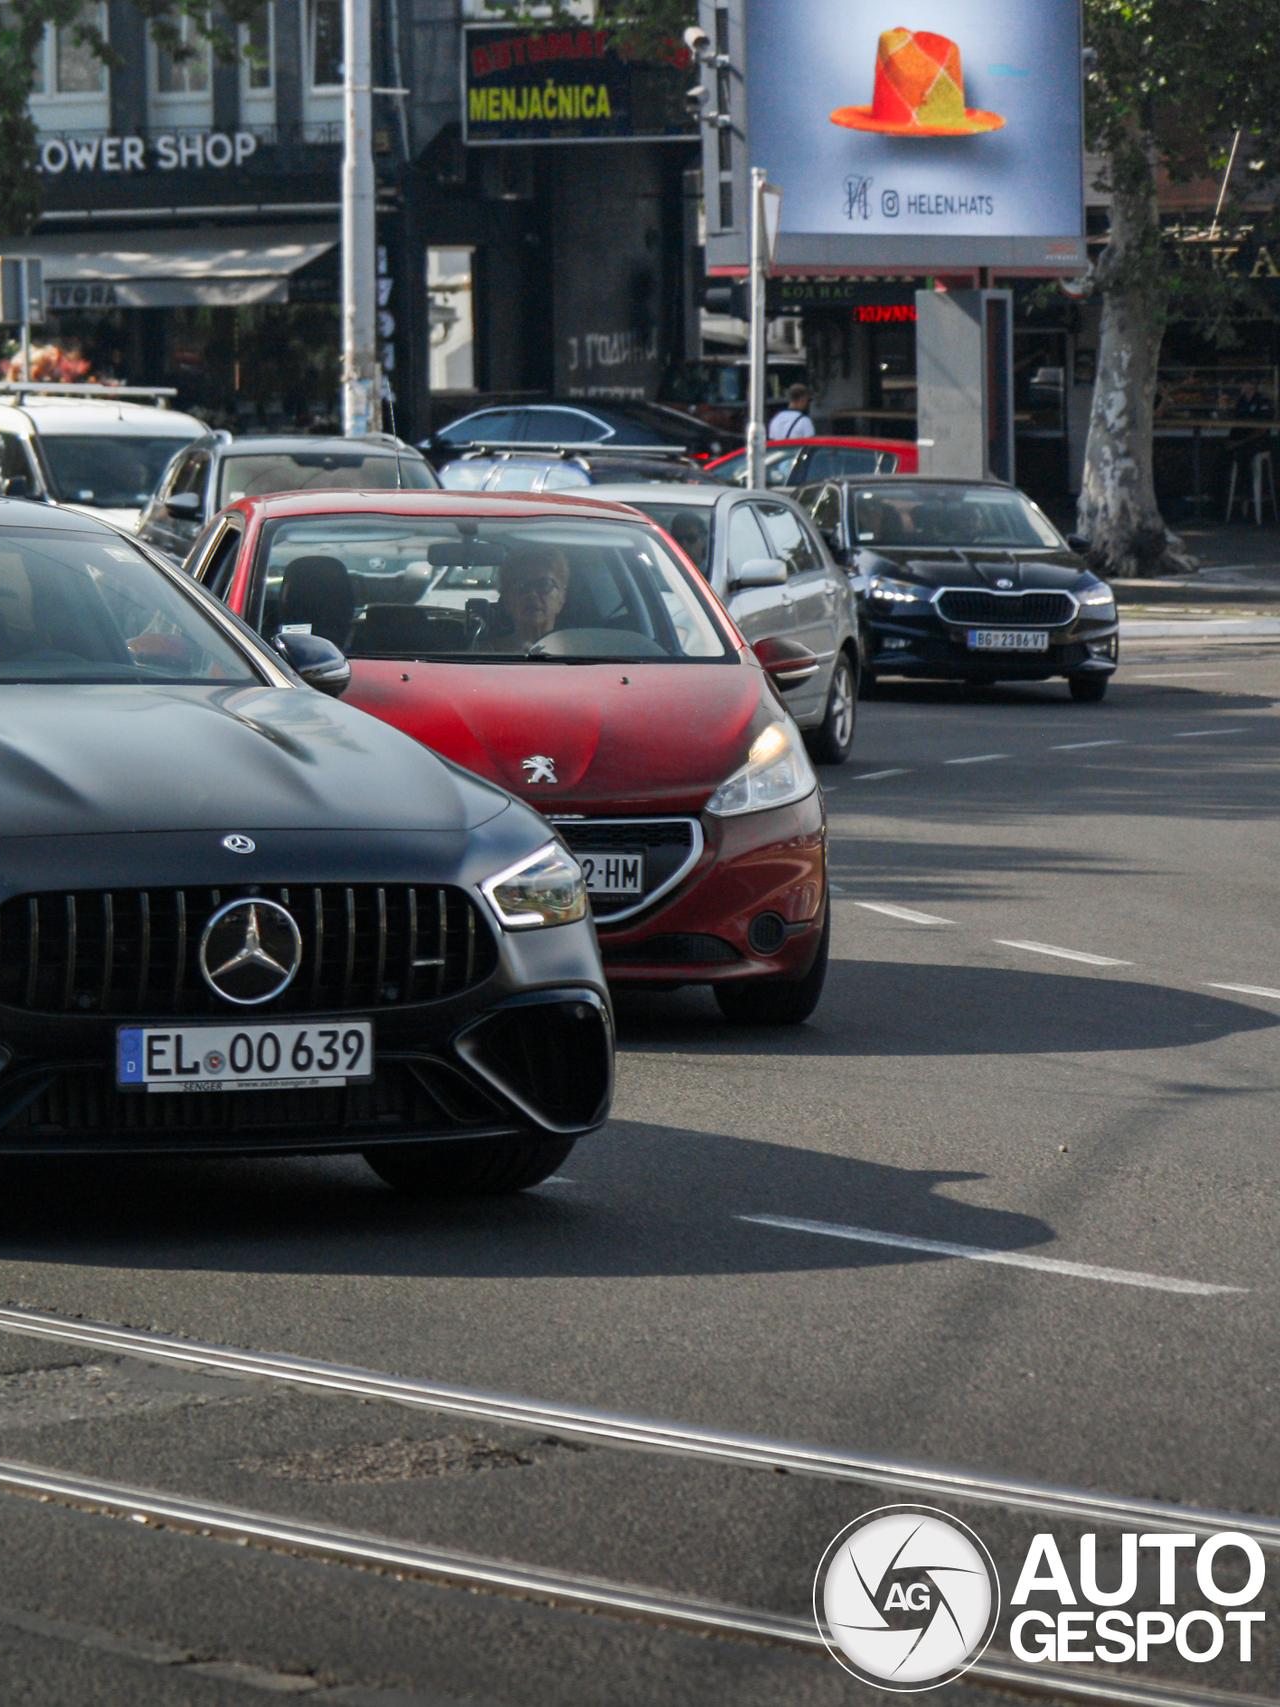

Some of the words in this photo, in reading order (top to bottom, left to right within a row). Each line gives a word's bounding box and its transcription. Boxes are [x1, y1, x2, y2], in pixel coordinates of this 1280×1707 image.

[470, 79, 611, 121] MENJAČNICA
[24, 136, 146, 174] OWER
[156, 132, 257, 169] SHOP
[907, 194, 994, 216] HELEN.HATS
[126, 1061, 136, 1073] D
[146, 1034, 200, 1076] EL
[291, 1029, 365, 1072] 639
[183, 1082, 223, 1092] SENGER
[237, 1077, 320, 1089] www.auto-senger.de
